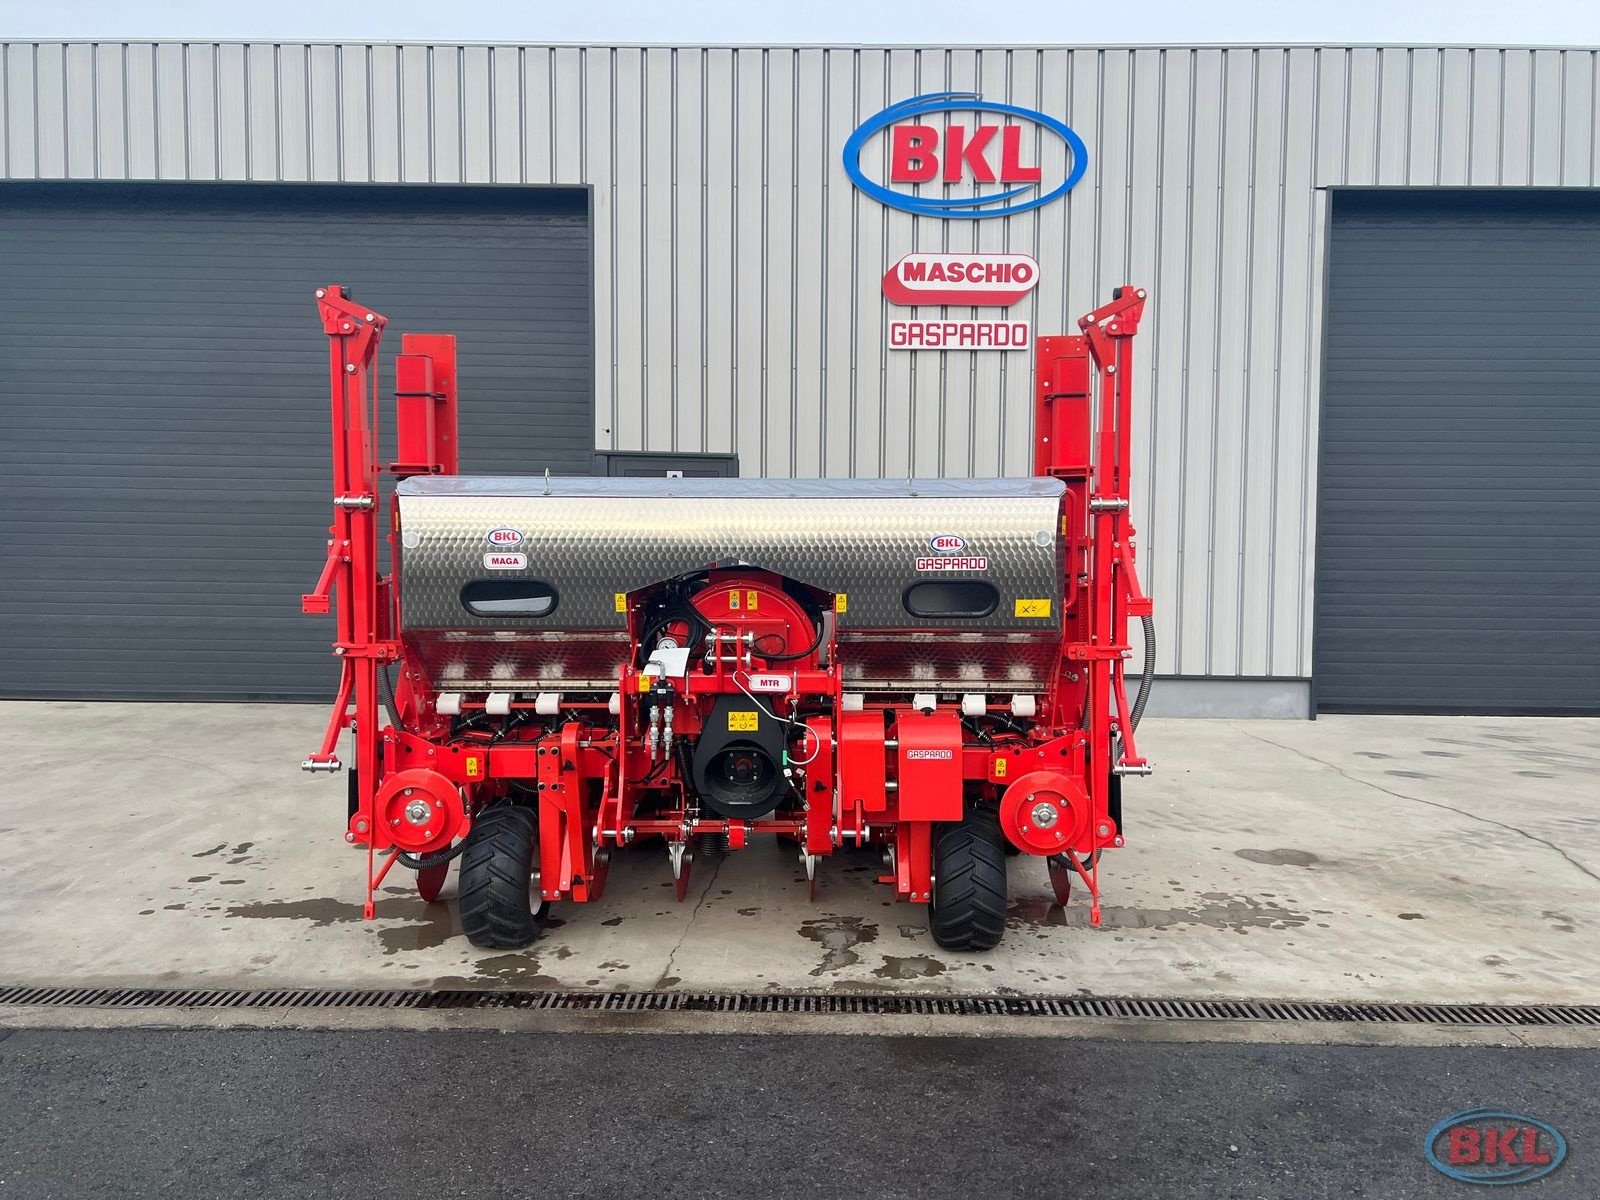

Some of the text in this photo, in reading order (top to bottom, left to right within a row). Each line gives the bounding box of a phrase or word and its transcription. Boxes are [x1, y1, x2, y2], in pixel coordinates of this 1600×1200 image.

[891, 125, 1042, 183] BKL
[903, 262, 1033, 283] MASCHIO
[890, 322, 1027, 347] GASPARDO
[494, 532, 518, 541] BKL
[937, 538, 961, 547] BKL
[491, 557, 519, 565] MAGA
[917, 558, 986, 570] GASPARDO
[760, 679, 780, 687] MTR
[907, 750, 952, 758] GASPARDO
